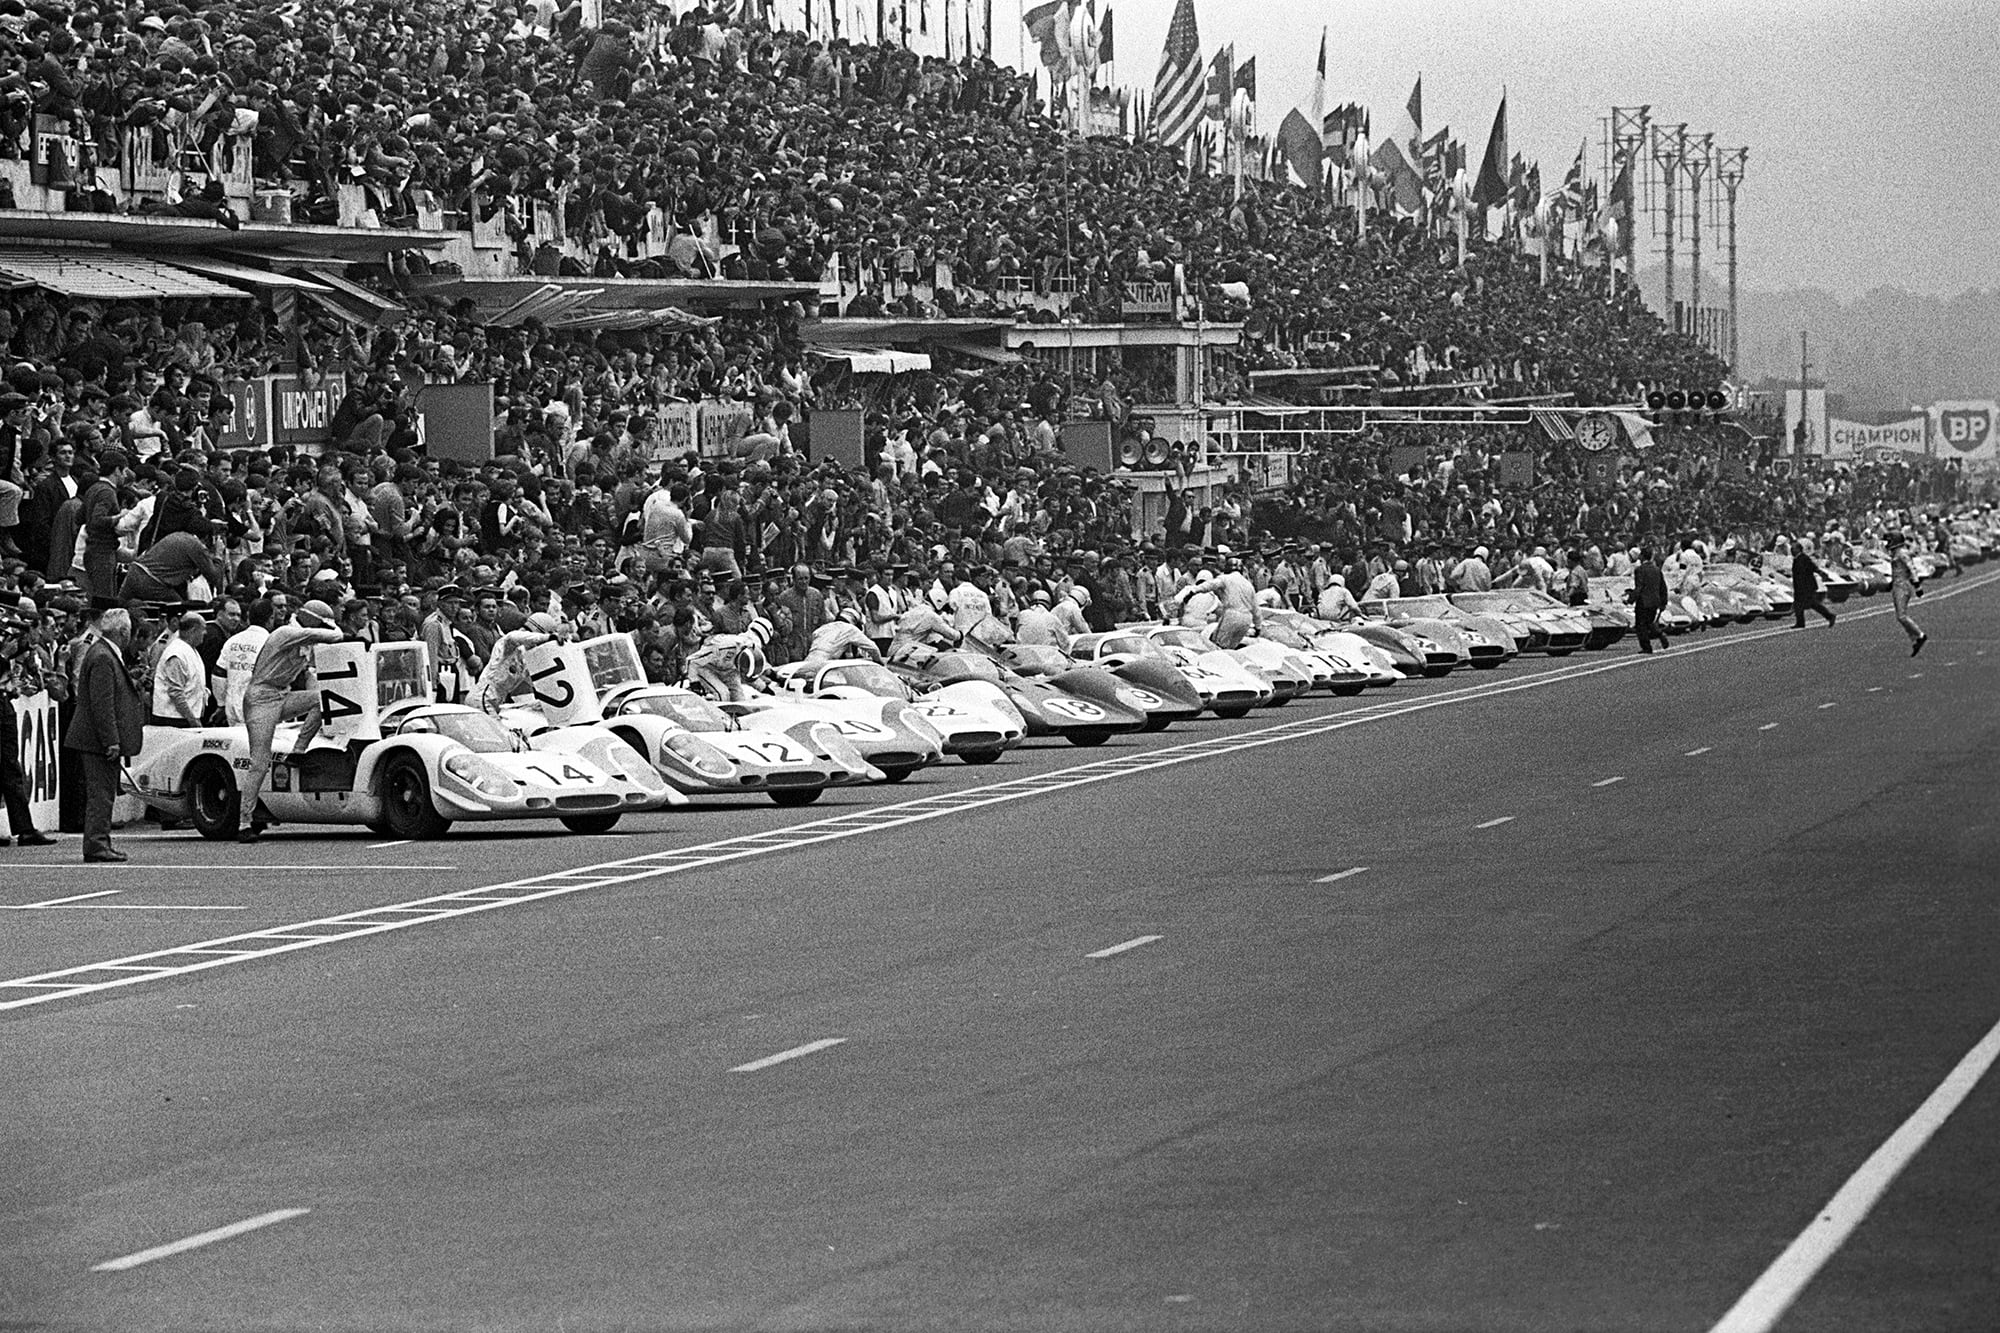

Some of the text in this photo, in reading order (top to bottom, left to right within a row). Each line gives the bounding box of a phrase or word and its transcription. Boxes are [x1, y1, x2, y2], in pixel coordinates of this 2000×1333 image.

[1834, 429, 1921, 444] CHAMPION
[1950, 416, 1986, 442] BP
[1312, 655, 1350, 668] 10
[530, 656, 574, 708] 12
[316, 661, 362, 726] 14
[1131, 690, 1160, 703] 9
[1047, 701, 1101, 716] 18
[829, 720, 881, 735] 20
[738, 743, 803, 763] 12
[526, 765, 594, 785] 14
